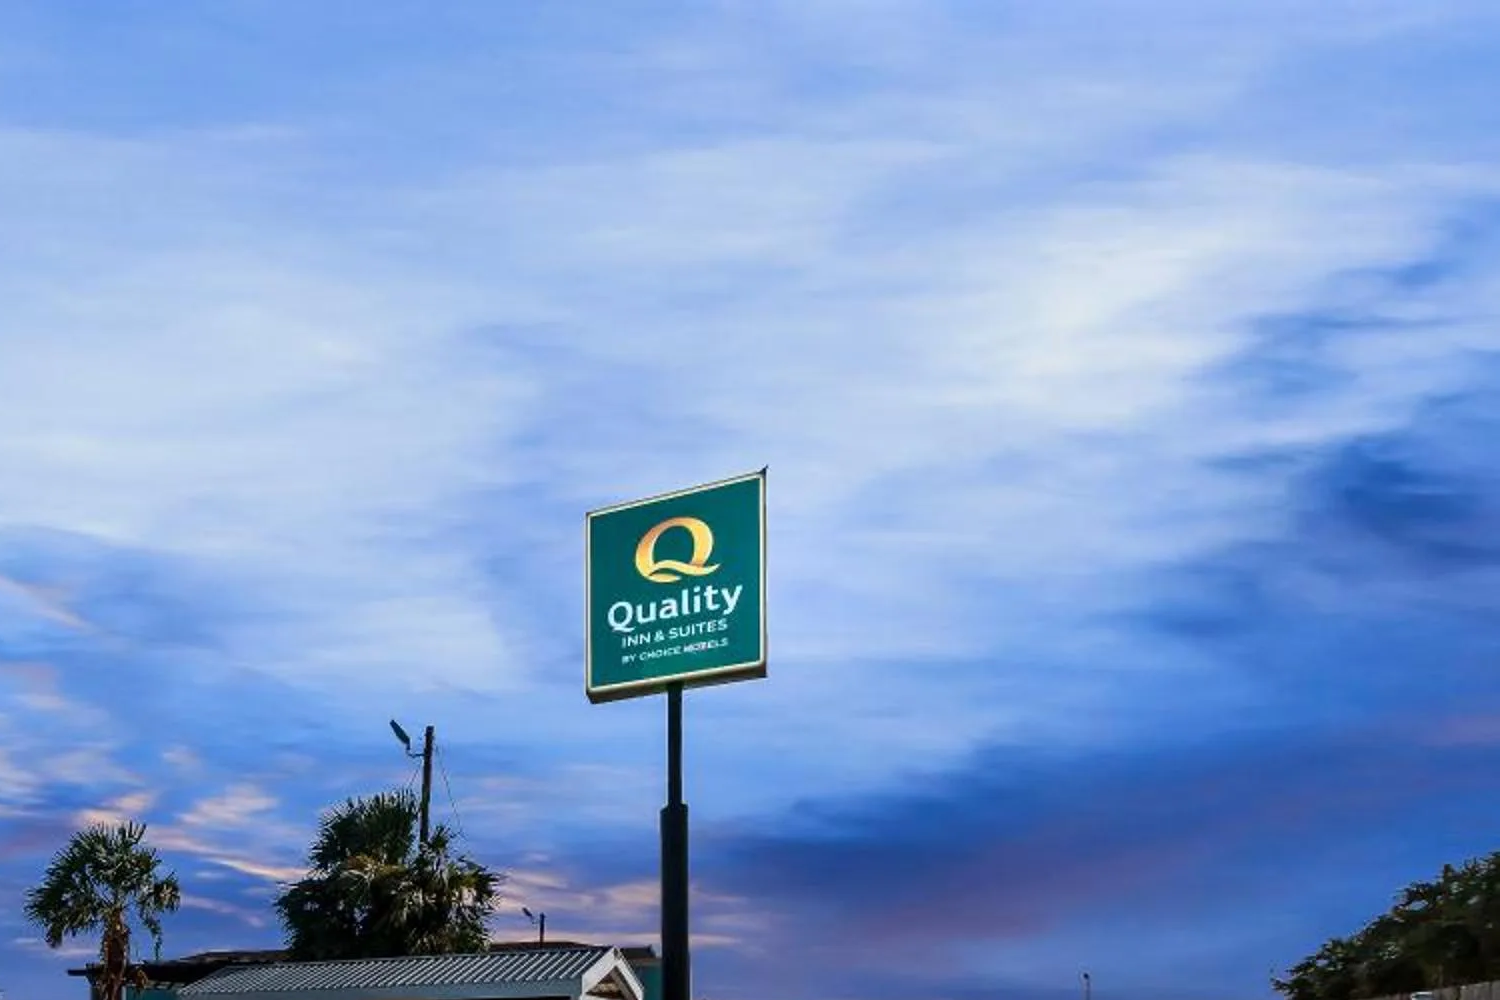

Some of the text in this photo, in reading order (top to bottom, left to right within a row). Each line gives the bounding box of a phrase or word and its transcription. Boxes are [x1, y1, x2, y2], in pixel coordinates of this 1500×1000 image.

[635, 516, 721, 583] Q
[607, 585, 743, 632] Quality
[621, 617, 729, 649] INN & SUITES
[621, 653, 636, 665] BY
[639, 646, 682, 661] CHOICE
